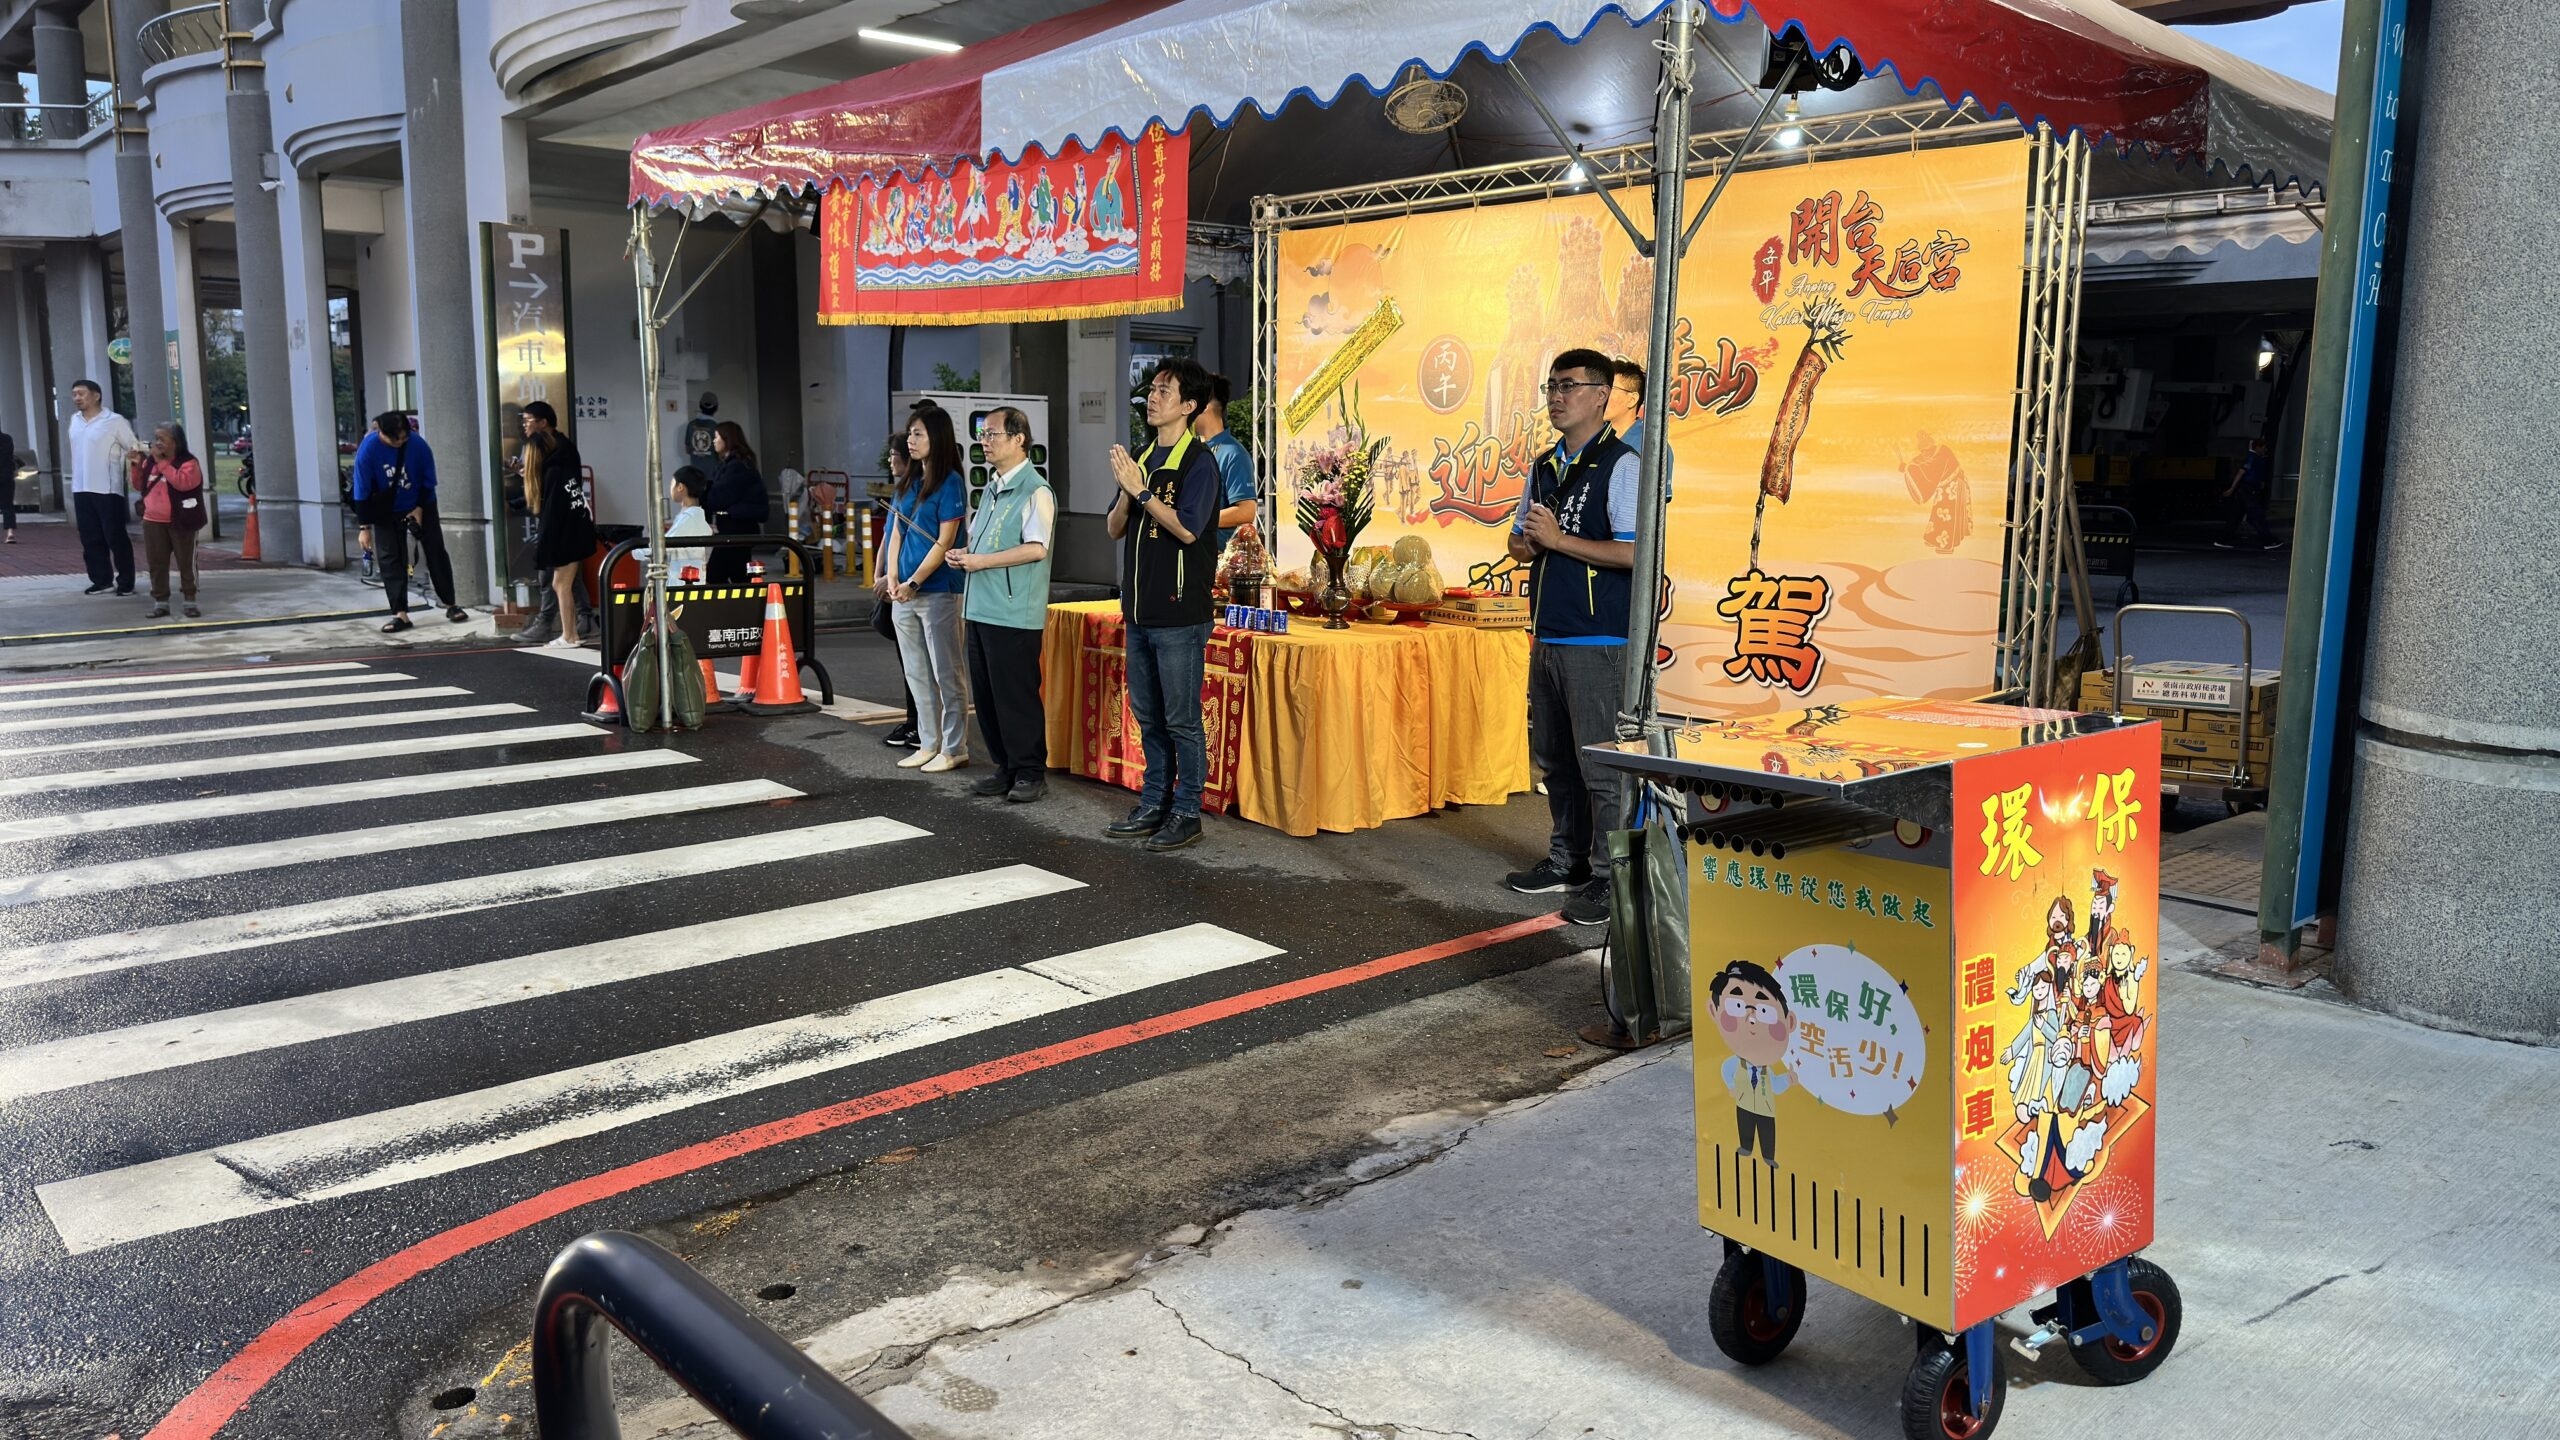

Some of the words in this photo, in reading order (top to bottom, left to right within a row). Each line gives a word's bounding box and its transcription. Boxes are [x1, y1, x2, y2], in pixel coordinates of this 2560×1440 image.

[507, 232, 545, 269] P
[1785, 274, 1836, 298] Anping
[1860, 299, 1913, 327] Temple
[1433, 342, 1457, 406] 丙午
[1163, 481, 1175, 507] 民政
[1559, 495, 1575, 535] 民政
[708, 627, 763, 643] 臺南市政
[1716, 568, 1831, 696] 駕
[2162, 681, 2226, 693] 臺南市政府秘書處
[1979, 767, 2141, 881] 環保
[1703, 855, 1935, 929] 響應環保從您我做起
[1962, 953, 1998, 1141] 禮炮車
